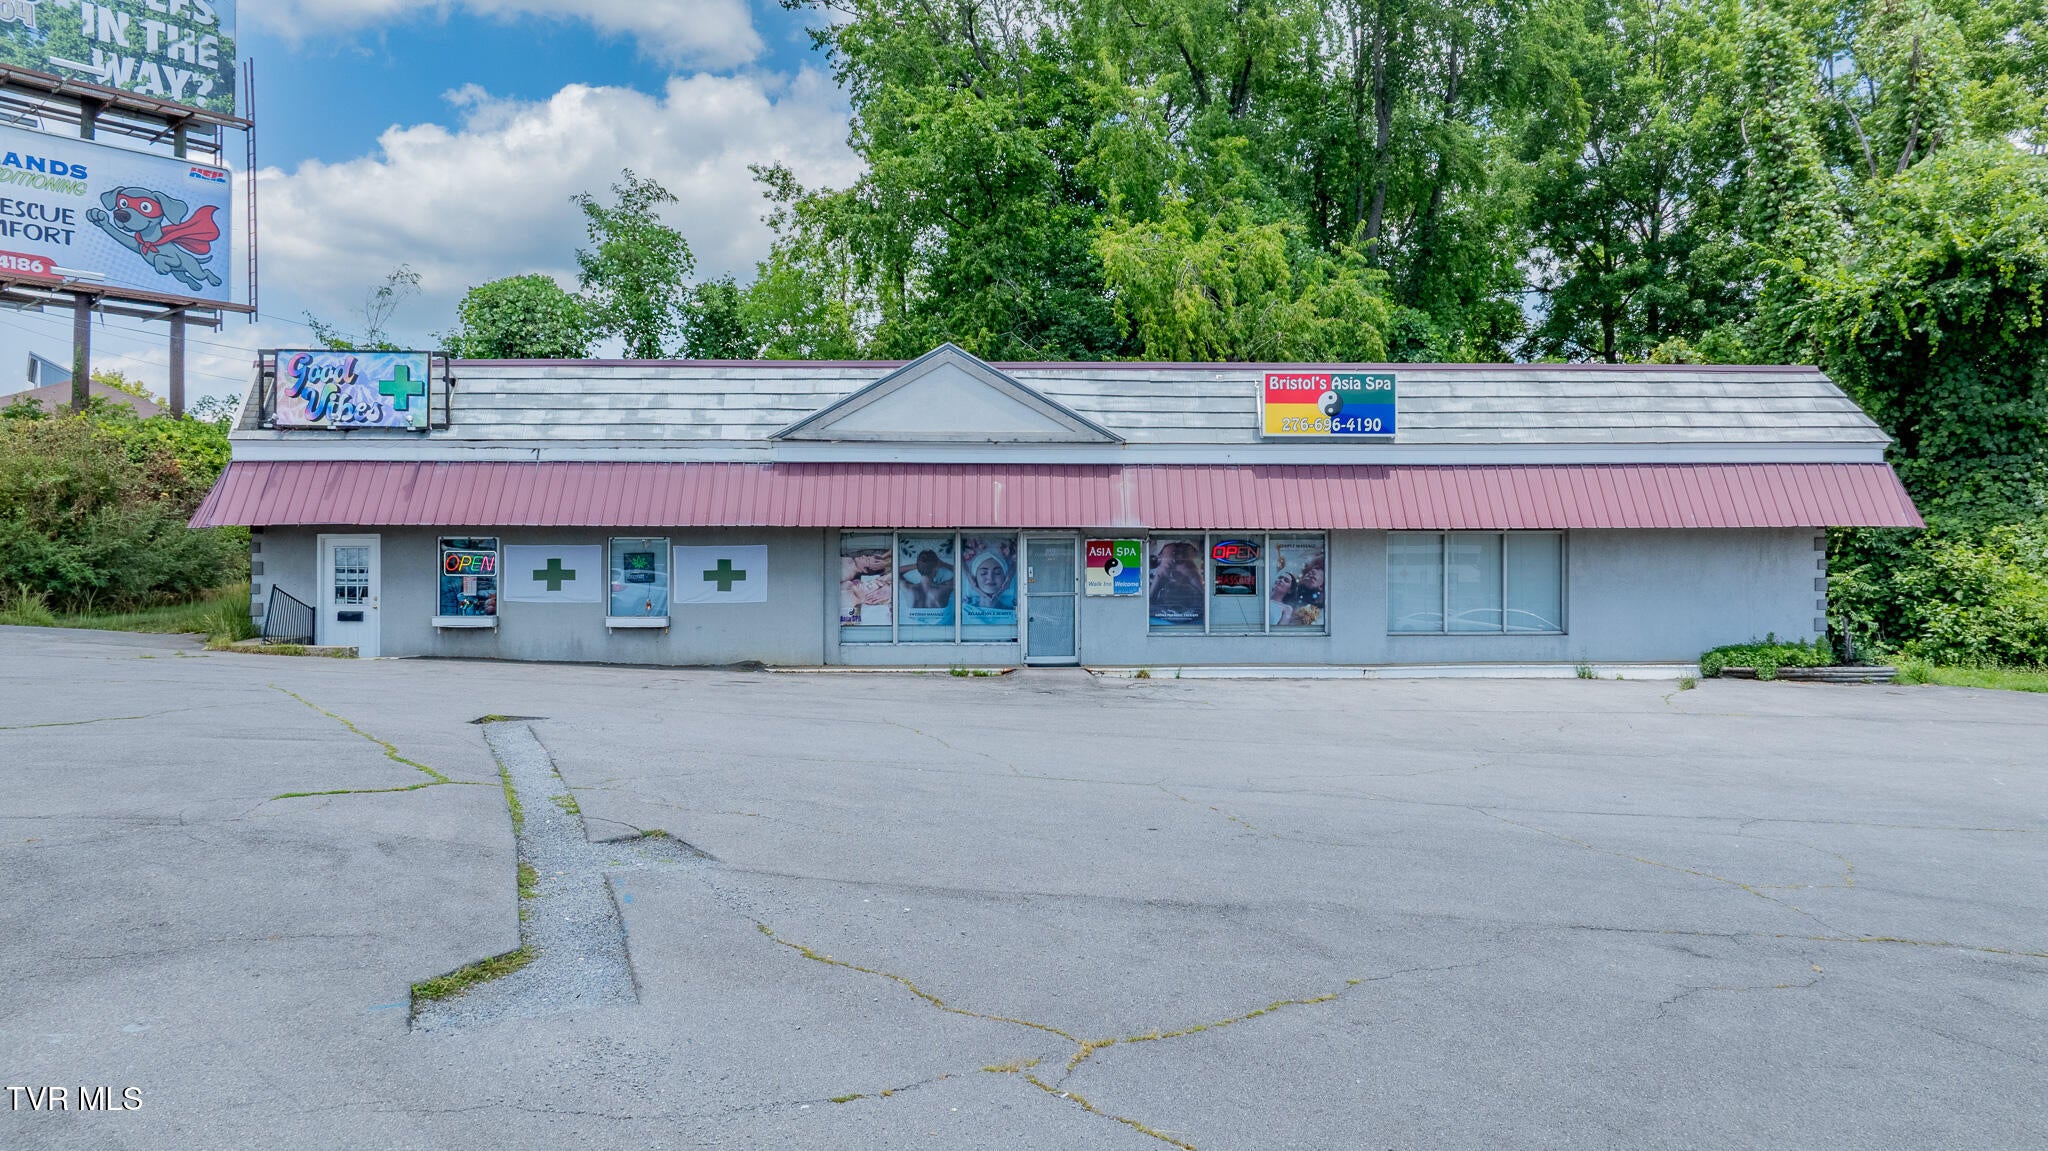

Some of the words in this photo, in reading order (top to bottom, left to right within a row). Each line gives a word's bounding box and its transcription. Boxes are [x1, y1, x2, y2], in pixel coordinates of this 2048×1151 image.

[82, 1, 130, 48] IN
[139, 18, 219, 70] THE
[91, 47, 214, 107] WAY?
[2, 151, 88, 180] ANDS
[285, 353, 358, 398] Good
[1269, 375, 1327, 391] Bristol's
[1331, 375, 1361, 391] Asia
[1365, 375, 1392, 391] Spa
[300, 383, 384, 423] Vibes
[1281, 416, 1382, 432] 276-696-4190
[445, 555, 495, 572] OPEN
[1212, 544, 1260, 559] OPEN
